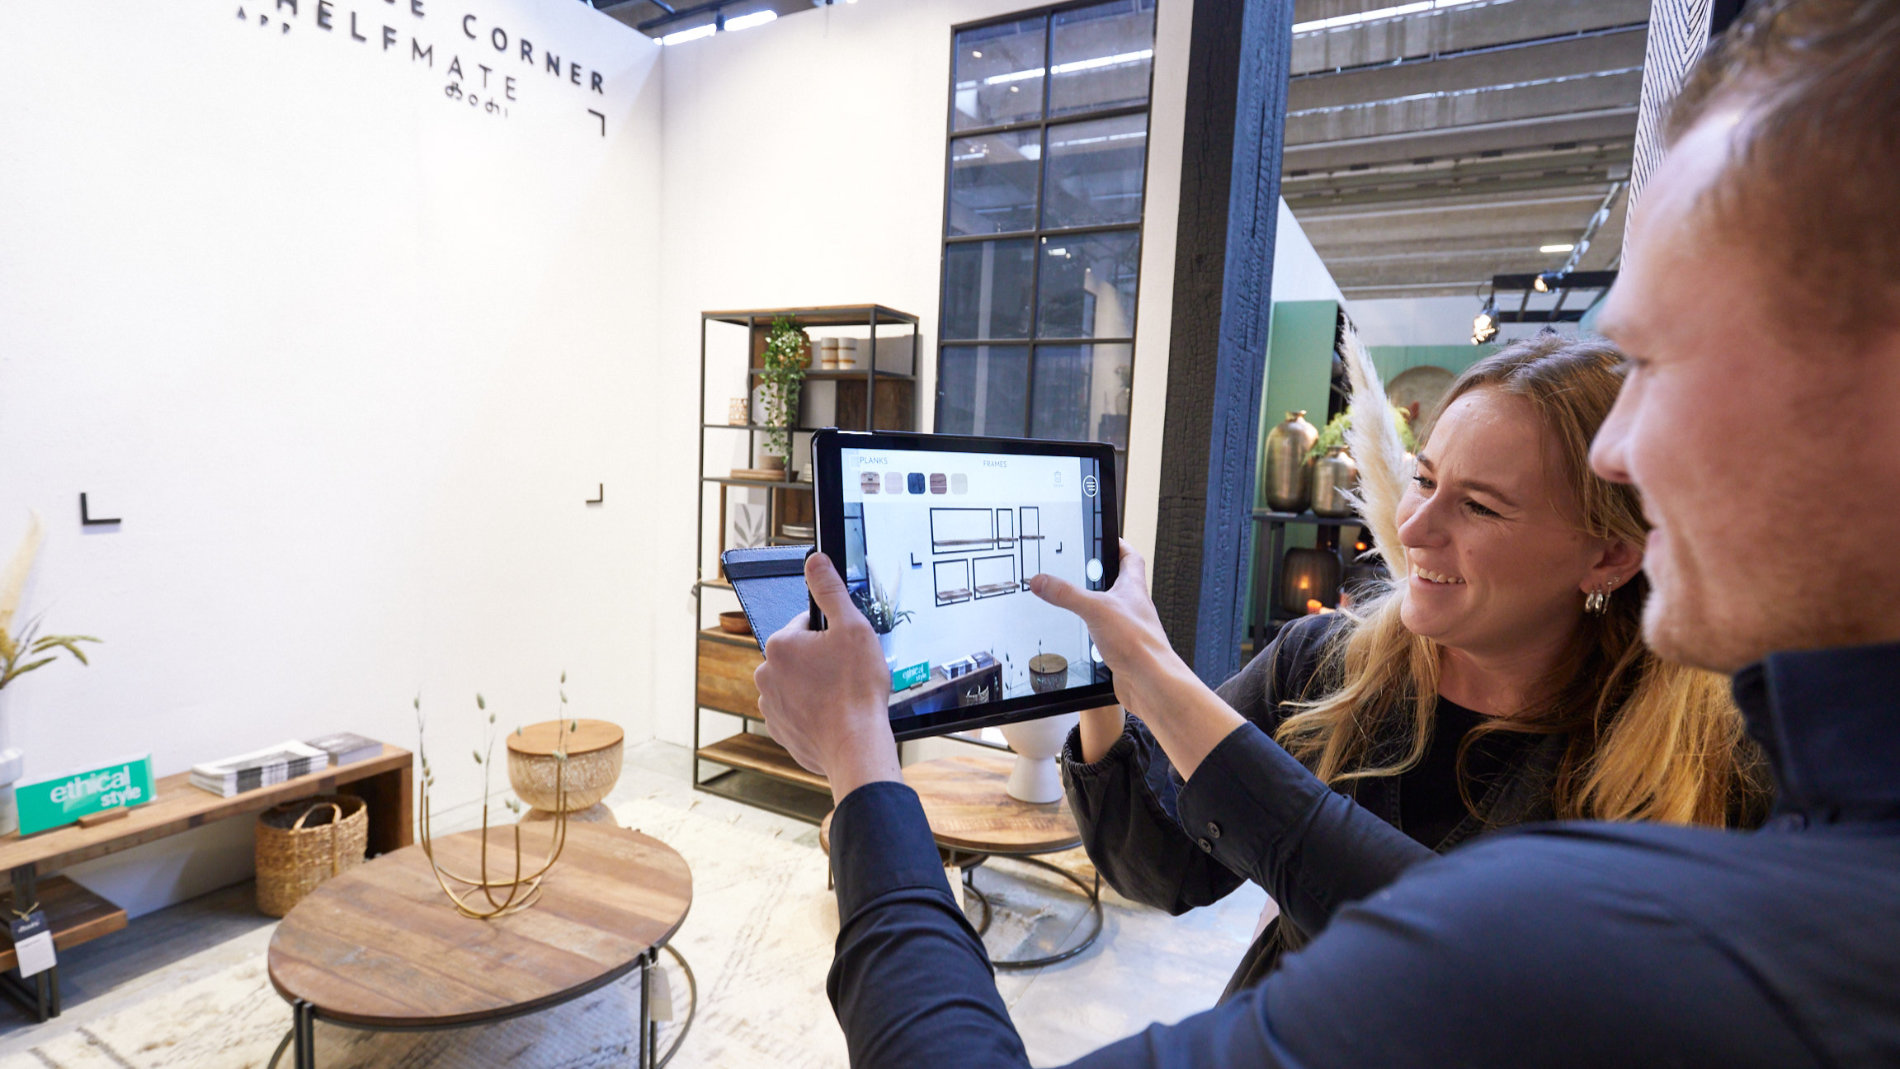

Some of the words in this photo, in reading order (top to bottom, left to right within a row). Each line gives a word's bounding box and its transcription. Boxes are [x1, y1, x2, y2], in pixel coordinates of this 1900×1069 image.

[462, 13, 604, 95] CORNER
[859, 456, 888, 465] PLANKS
[982, 459, 1008, 469] FRAMES
[50, 765, 131, 803] ethical
[101, 785, 141, 807] style
